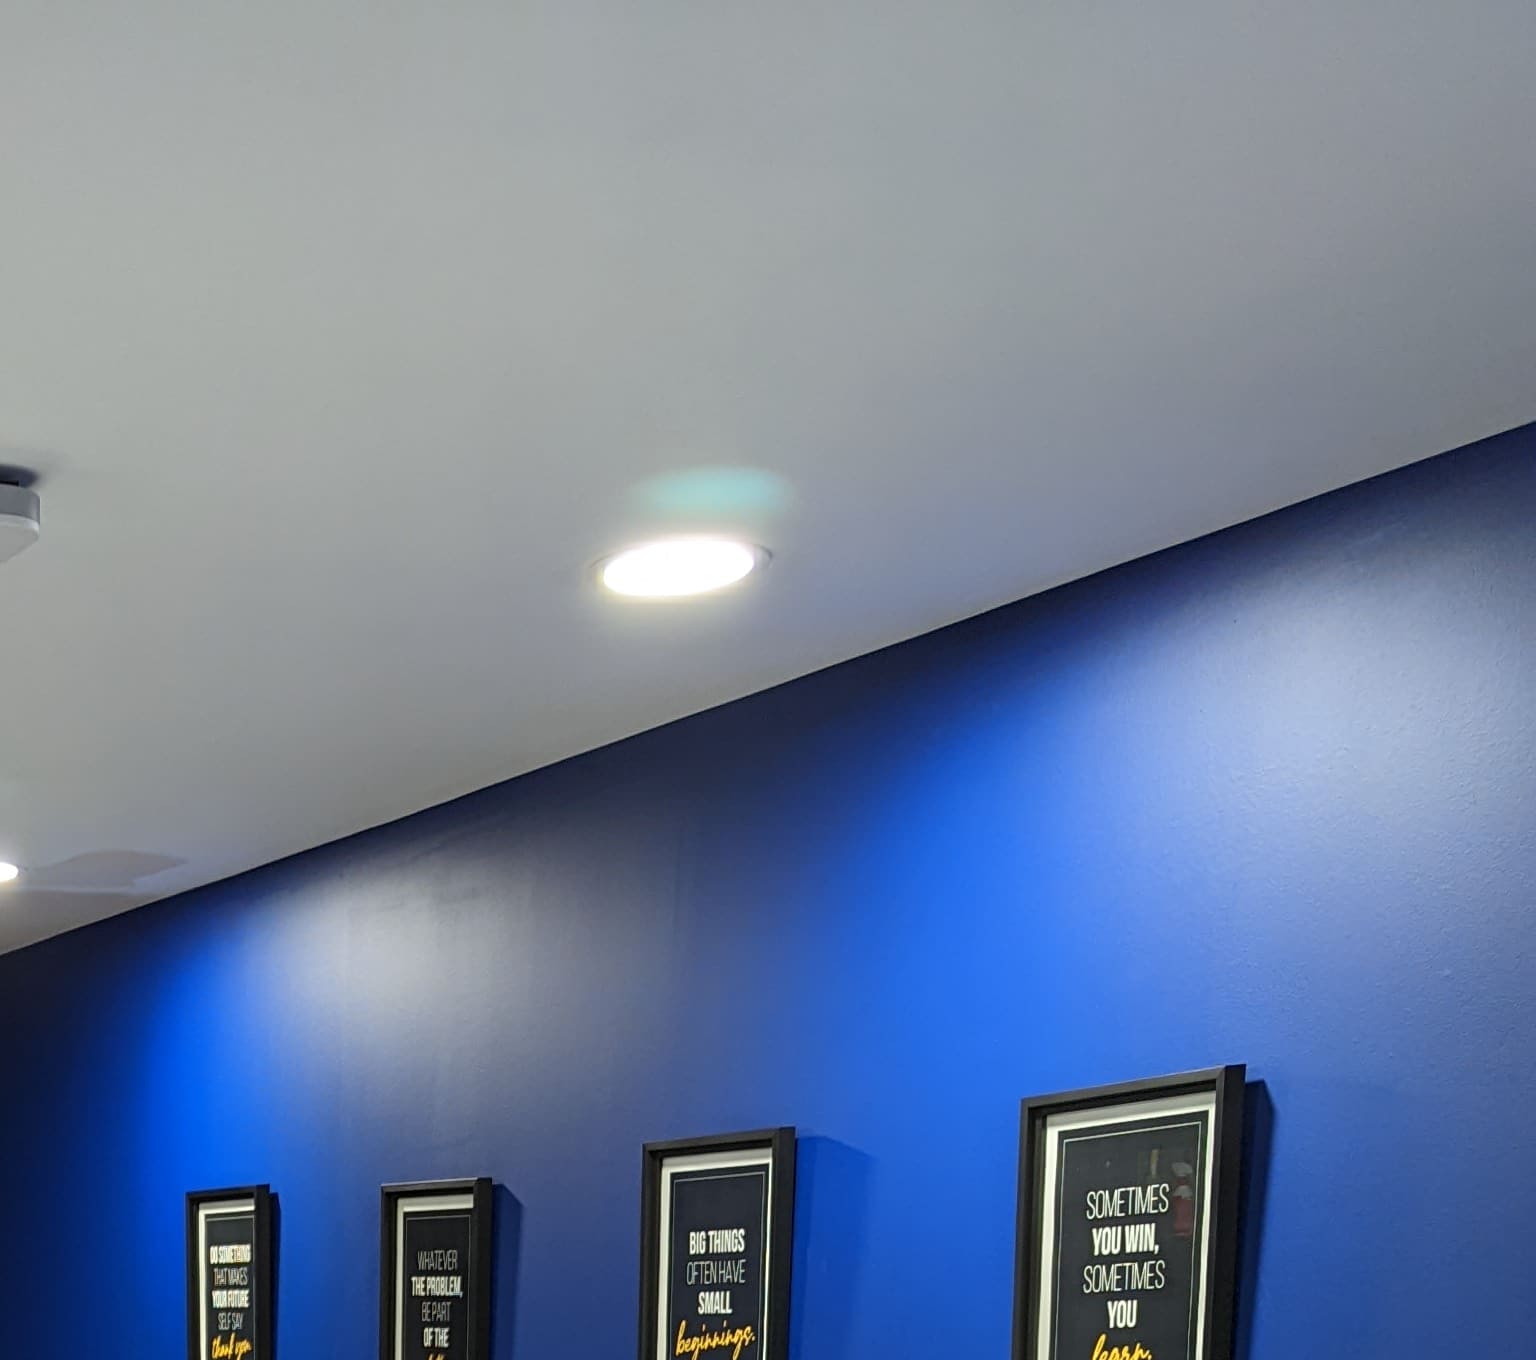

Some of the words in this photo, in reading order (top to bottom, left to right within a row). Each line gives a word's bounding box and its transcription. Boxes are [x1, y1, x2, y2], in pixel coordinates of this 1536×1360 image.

[1086, 1183, 1169, 1220] SOMETIMES
[689, 1231, 706, 1255] BIG
[708, 1228, 745, 1254] THINGS
[1092, 1226, 1122, 1256] YOU
[1124, 1223, 1160, 1255] WIN,
[417, 1249, 458, 1271] WHATEVER
[686, 1261, 717, 1286] OFTEN
[718, 1259, 746, 1284] HAVE
[411, 1276, 426, 1297] THE
[1083, 1260, 1166, 1293] SOMETIMES
[421, 1302, 431, 1322] BE
[431, 1301, 451, 1322] PART
[698, 1291, 733, 1314] SMALL
[1107, 1299, 1138, 1329] YOU
[423, 1327, 433, 1347] OF
[434, 1327, 450, 1348] THE
